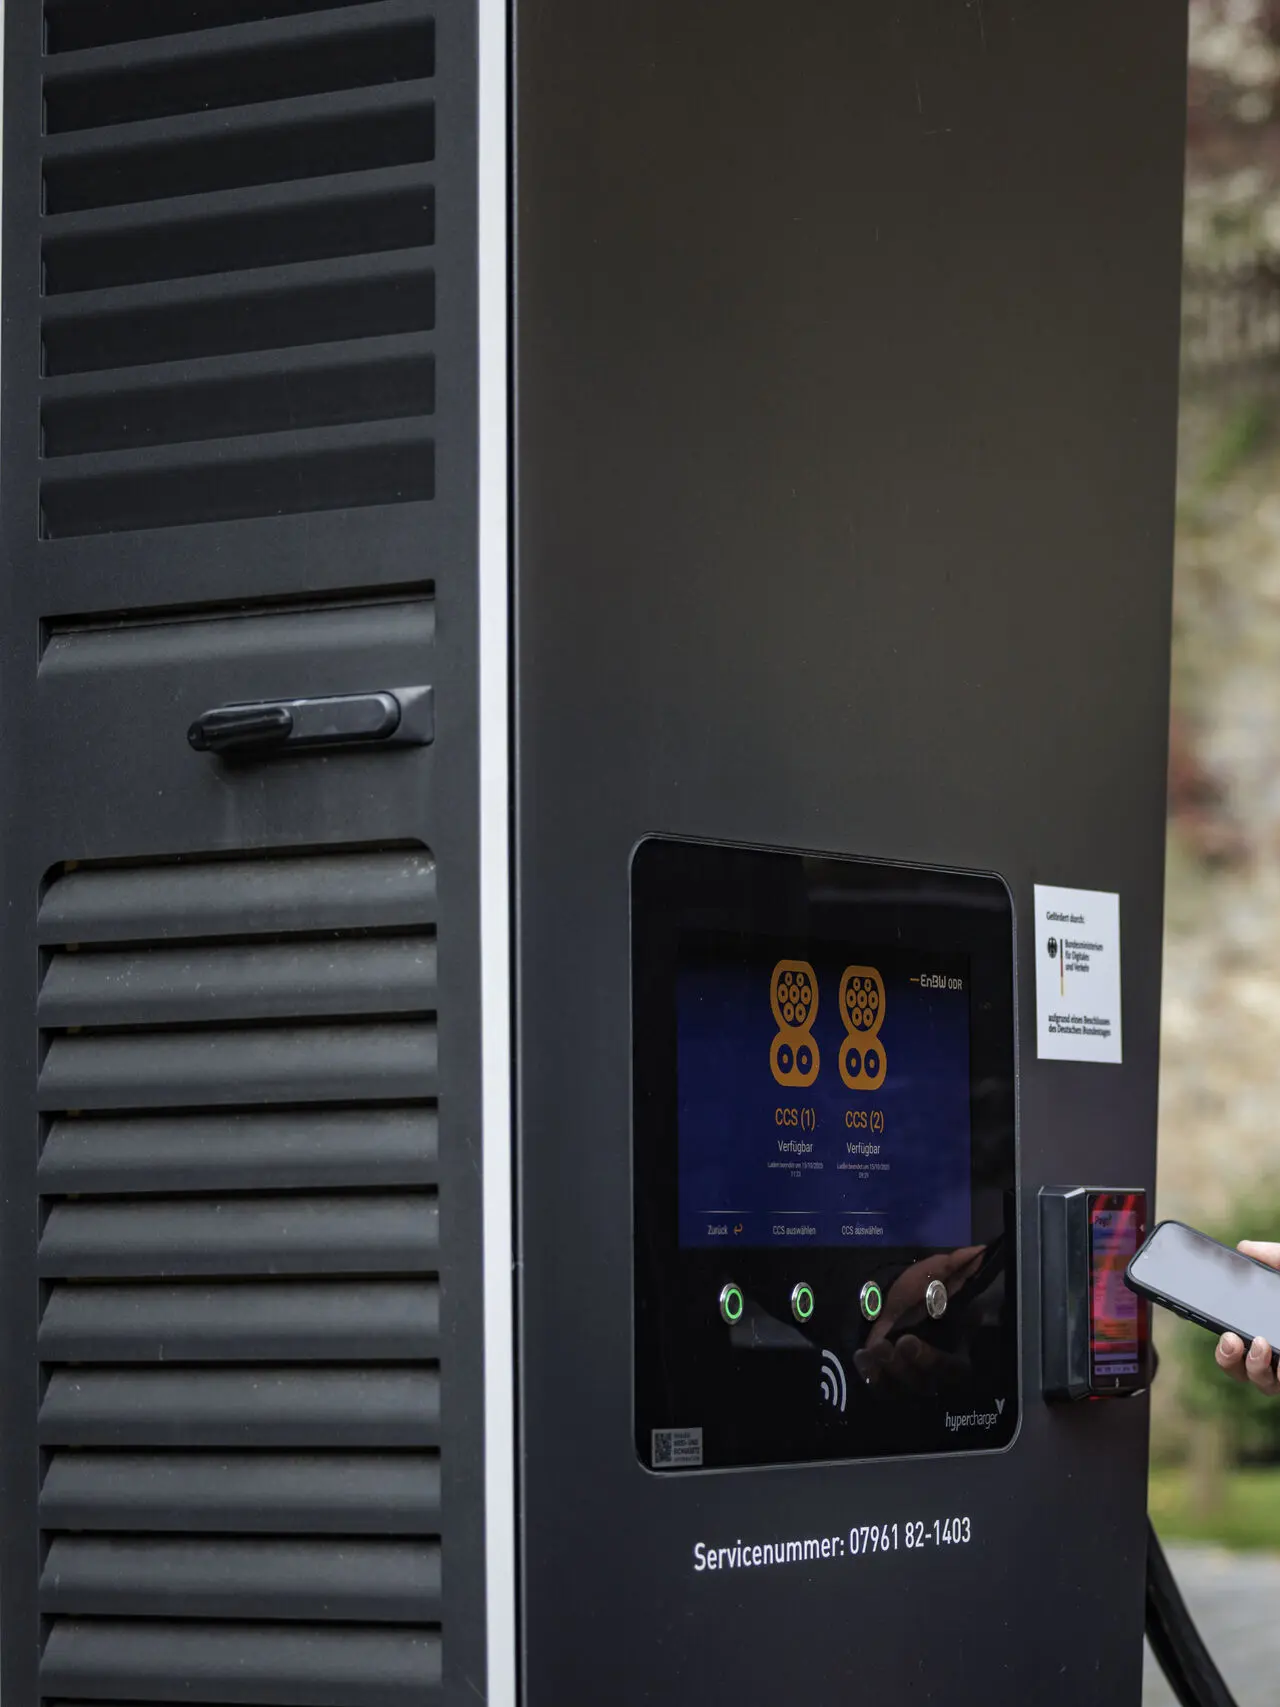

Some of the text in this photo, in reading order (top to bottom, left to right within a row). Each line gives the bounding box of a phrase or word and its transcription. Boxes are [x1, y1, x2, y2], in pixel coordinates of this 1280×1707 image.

[920, 974, 963, 990] EnBW ODR
[775, 1107, 815, 1131] CCS (1)
[845, 1110, 884, 1133] CCS (2)
[777, 1140, 813, 1155] Verfügbar
[846, 1142, 881, 1157] Verfügbar
[707, 1224, 728, 1235] Zurück
[773, 1225, 816, 1235] CCS auswählen
[841, 1225, 883, 1235] CCS auswählen
[945, 1410, 998, 1432] hypercharger
[694, 1516, 971, 1572] Servicenummer: 07961 82-1403
